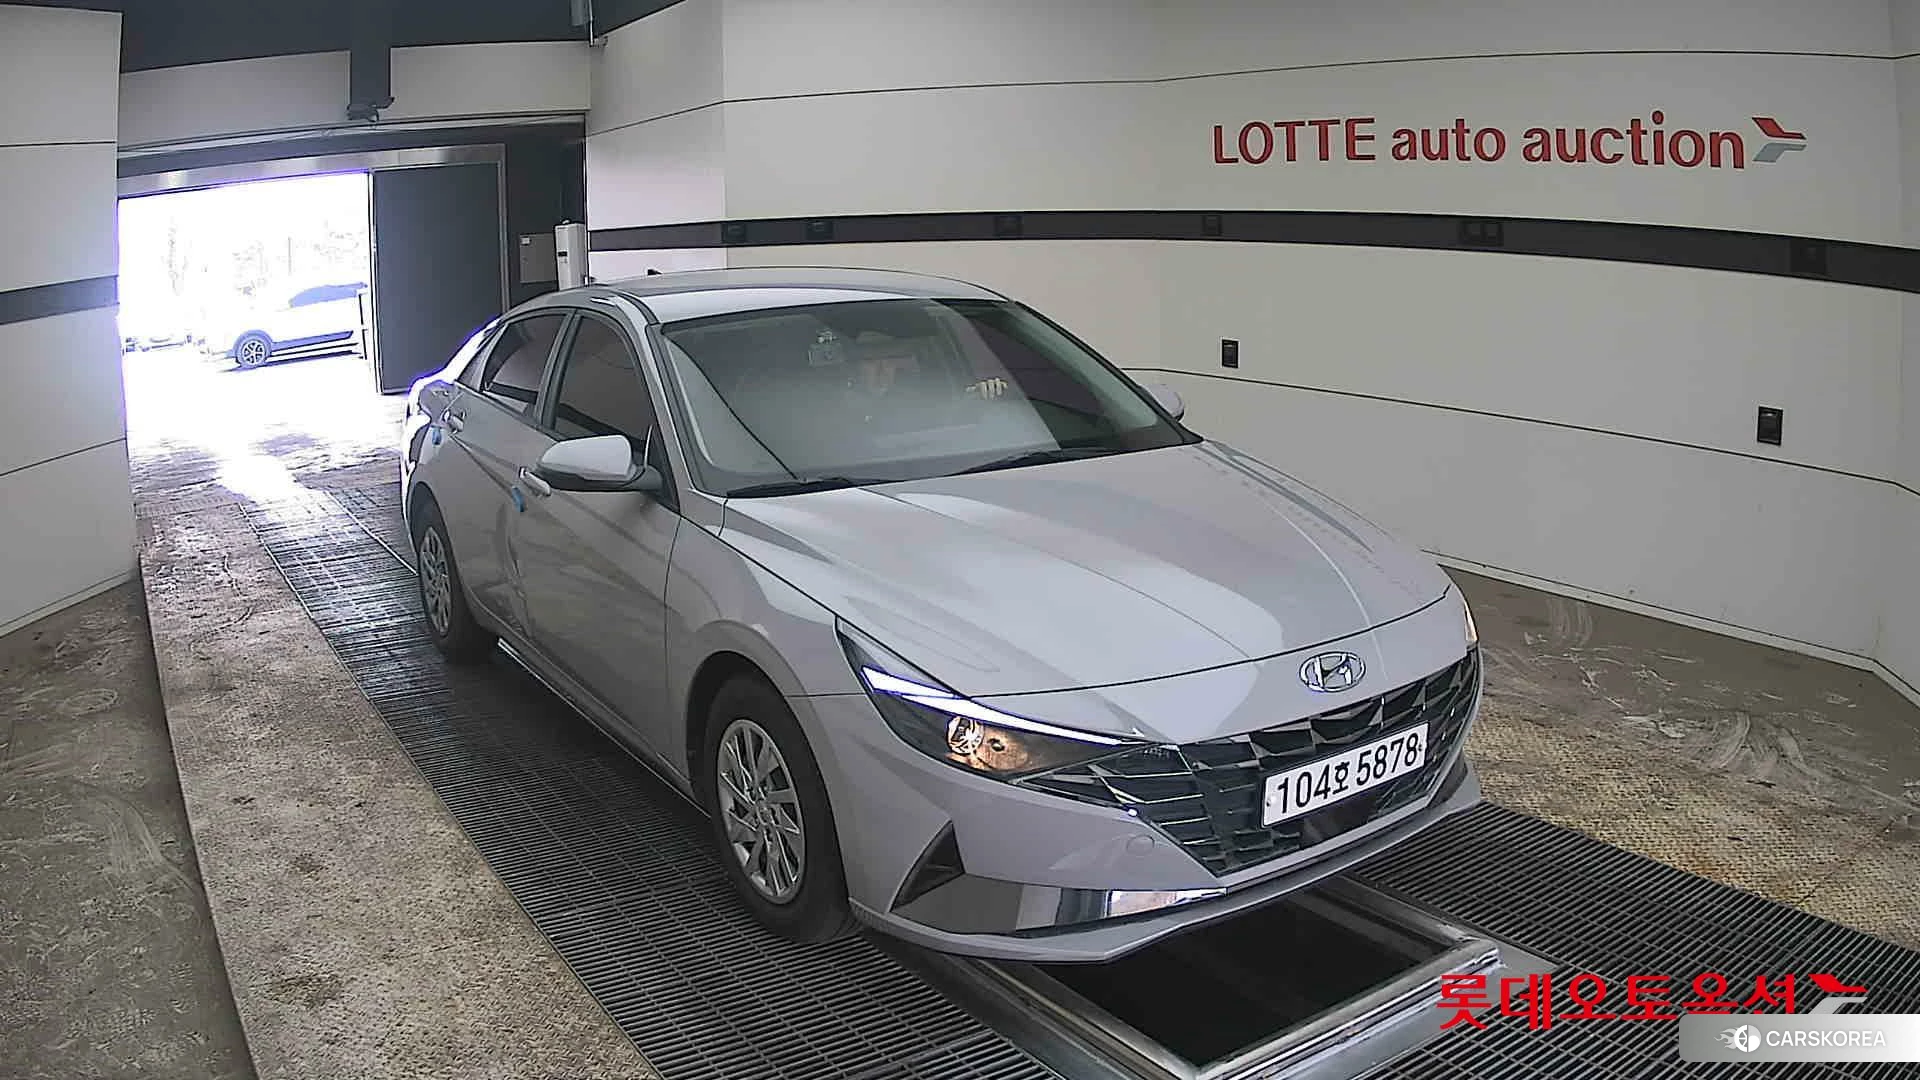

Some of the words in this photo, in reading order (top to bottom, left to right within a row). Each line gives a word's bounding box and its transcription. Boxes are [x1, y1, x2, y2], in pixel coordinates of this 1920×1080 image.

[1213, 117, 1376, 164] LOTTE
[1391, 118, 1507, 162] auto
[1522, 110, 1746, 168] auction
[1277, 761, 1350, 814] 104호
[1356, 732, 1419, 786] 5878
